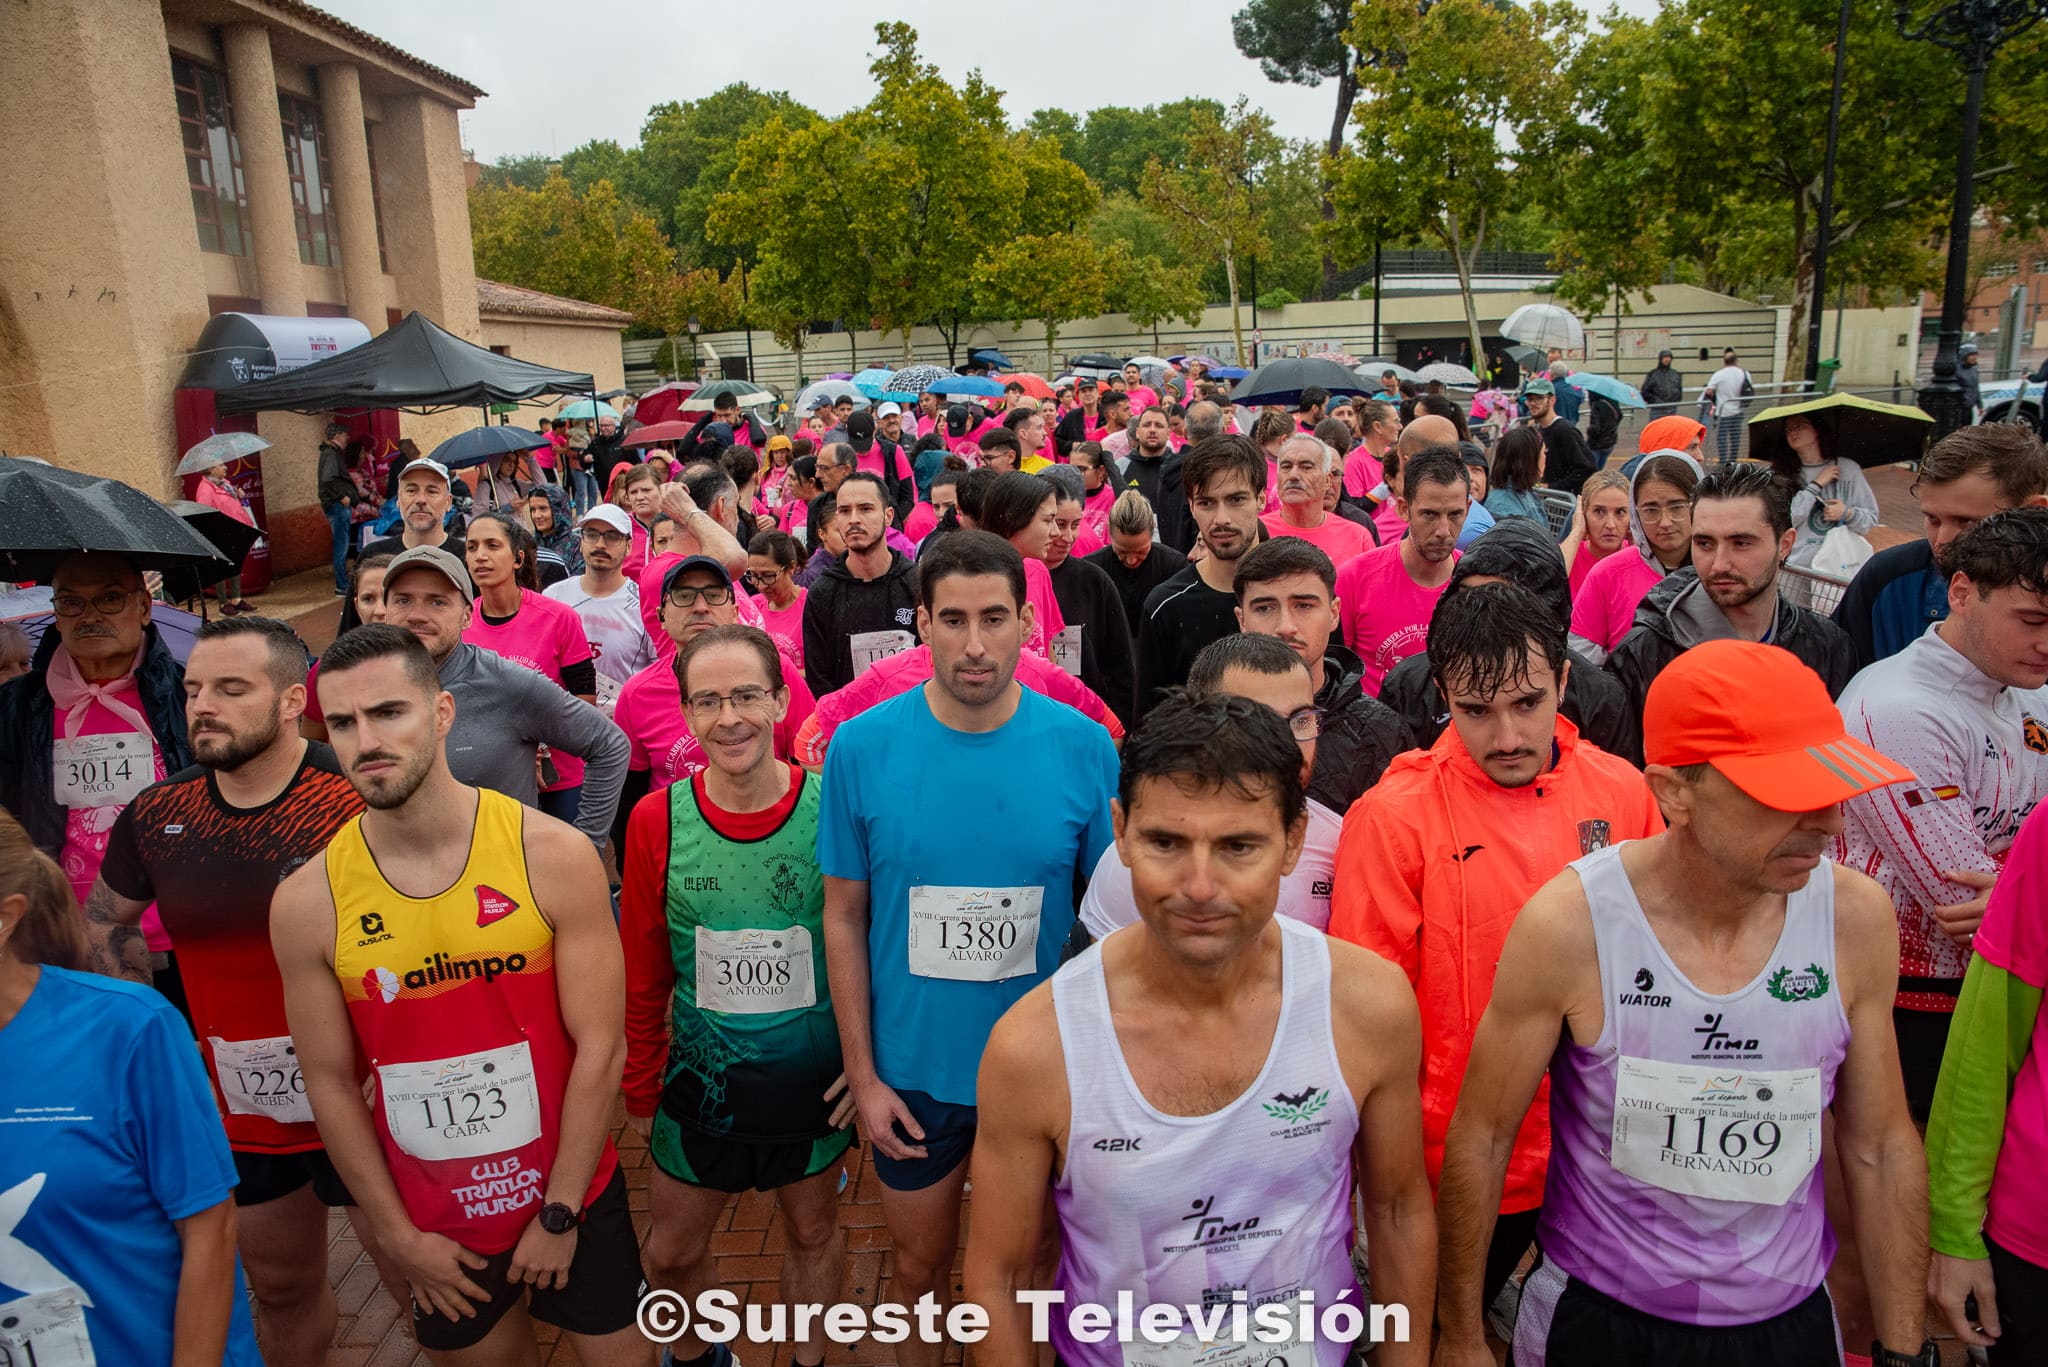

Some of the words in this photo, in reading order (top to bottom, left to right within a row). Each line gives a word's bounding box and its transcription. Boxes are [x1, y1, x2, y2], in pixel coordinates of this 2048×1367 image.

[1378, 630, 1405, 654] CARRERA
[1404, 624, 1418, 634] POR
[666, 734, 691, 762] CARRERA
[67, 759, 132, 785] 3014
[83, 782, 115, 793] PACO
[913, 911, 932, 920] XVIII
[961, 915, 973, 923] por
[938, 920, 1016, 950] 1380
[740, 954, 751, 962] por
[948, 947, 1003, 961] ÁLVARO
[404, 952, 527, 990] ailimpo
[717, 960, 791, 986] 3008
[726, 985, 784, 995] ANTONIO
[1619, 993, 1672, 1008] VIATOR
[236, 1068, 307, 1096] 1226
[388, 1093, 411, 1103] XVIII
[412, 1090, 441, 1100] Carrera
[442, 1088, 455, 1098] por
[457, 1086, 465, 1094] la
[466, 1082, 488, 1093] salud
[489, 1079, 499, 1088] de
[500, 1077, 508, 1086] la
[509, 1072, 532, 1085] mujer
[420, 1087, 507, 1129] 1123
[1717, 1093, 1748, 1102] deporte
[1620, 1097, 1652, 1110] XVIII
[1655, 1103, 1695, 1115] Carrera
[1698, 1108, 1715, 1120] por
[1719, 1107, 1729, 1117] la
[1731, 1109, 1760, 1121] salud
[1762, 1111, 1776, 1121] de
[1779, 1111, 1788, 1121] la
[1790, 1111, 1817, 1124] mujer
[443, 1121, 491, 1139] CABA
[1284, 1127, 1321, 1139] ALBACETE
[1292, 1119, 1331, 1133] ATLETISMO
[1661, 1114, 1781, 1160] 1169
[1093, 1137, 1142, 1151] 42K
[471, 1156, 520, 1181] CLUB
[1660, 1150, 1773, 1177] FERNANDO
[451, 1168, 542, 1203] TRIATLON
[464, 1186, 543, 1219] MURCIA
[1237, 1233, 1246, 1241] DE
[1248, 1229, 1283, 1239] DEPORTES
[1206, 1244, 1240, 1255] ALBACETE
[1237, 1352, 1264, 1367] salud
[1266, 1347, 1278, 1358] de
[1280, 1342, 1290, 1353] la
